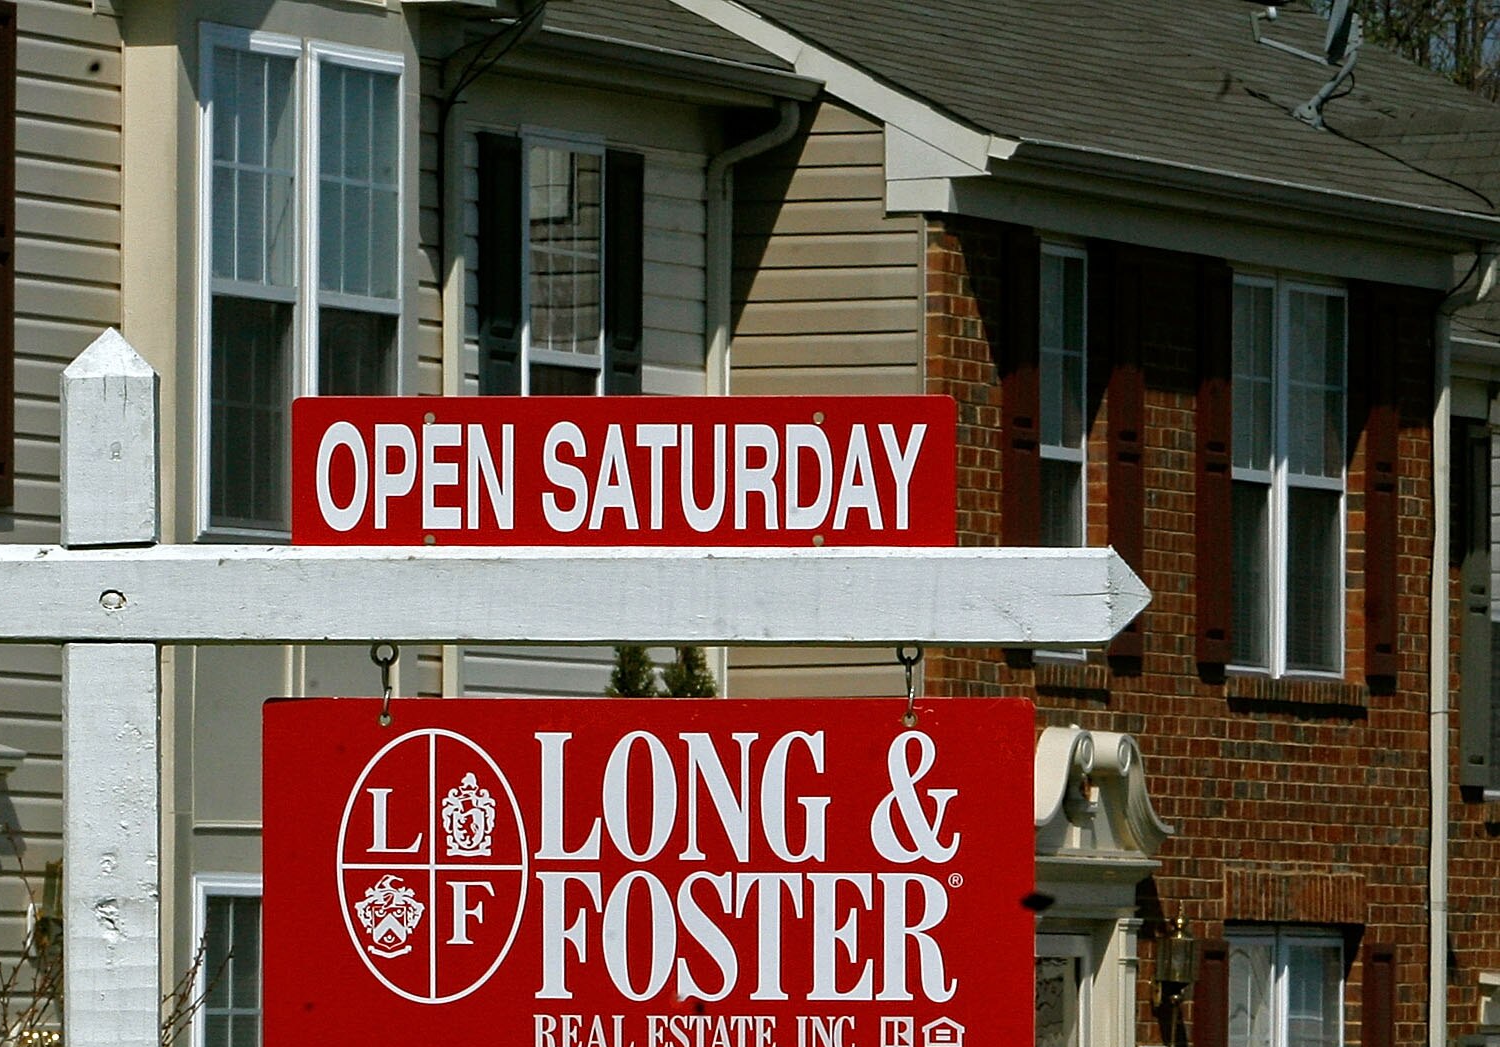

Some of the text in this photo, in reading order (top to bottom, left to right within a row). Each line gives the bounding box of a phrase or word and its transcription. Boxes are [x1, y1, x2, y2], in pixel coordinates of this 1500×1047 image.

[316, 421, 927, 532] OPEN SATURDAY
[367, 788, 422, 852] L
[534, 730, 961, 863] LONG &
[446, 881, 494, 945] F
[534, 870, 959, 1003] FOSTER
